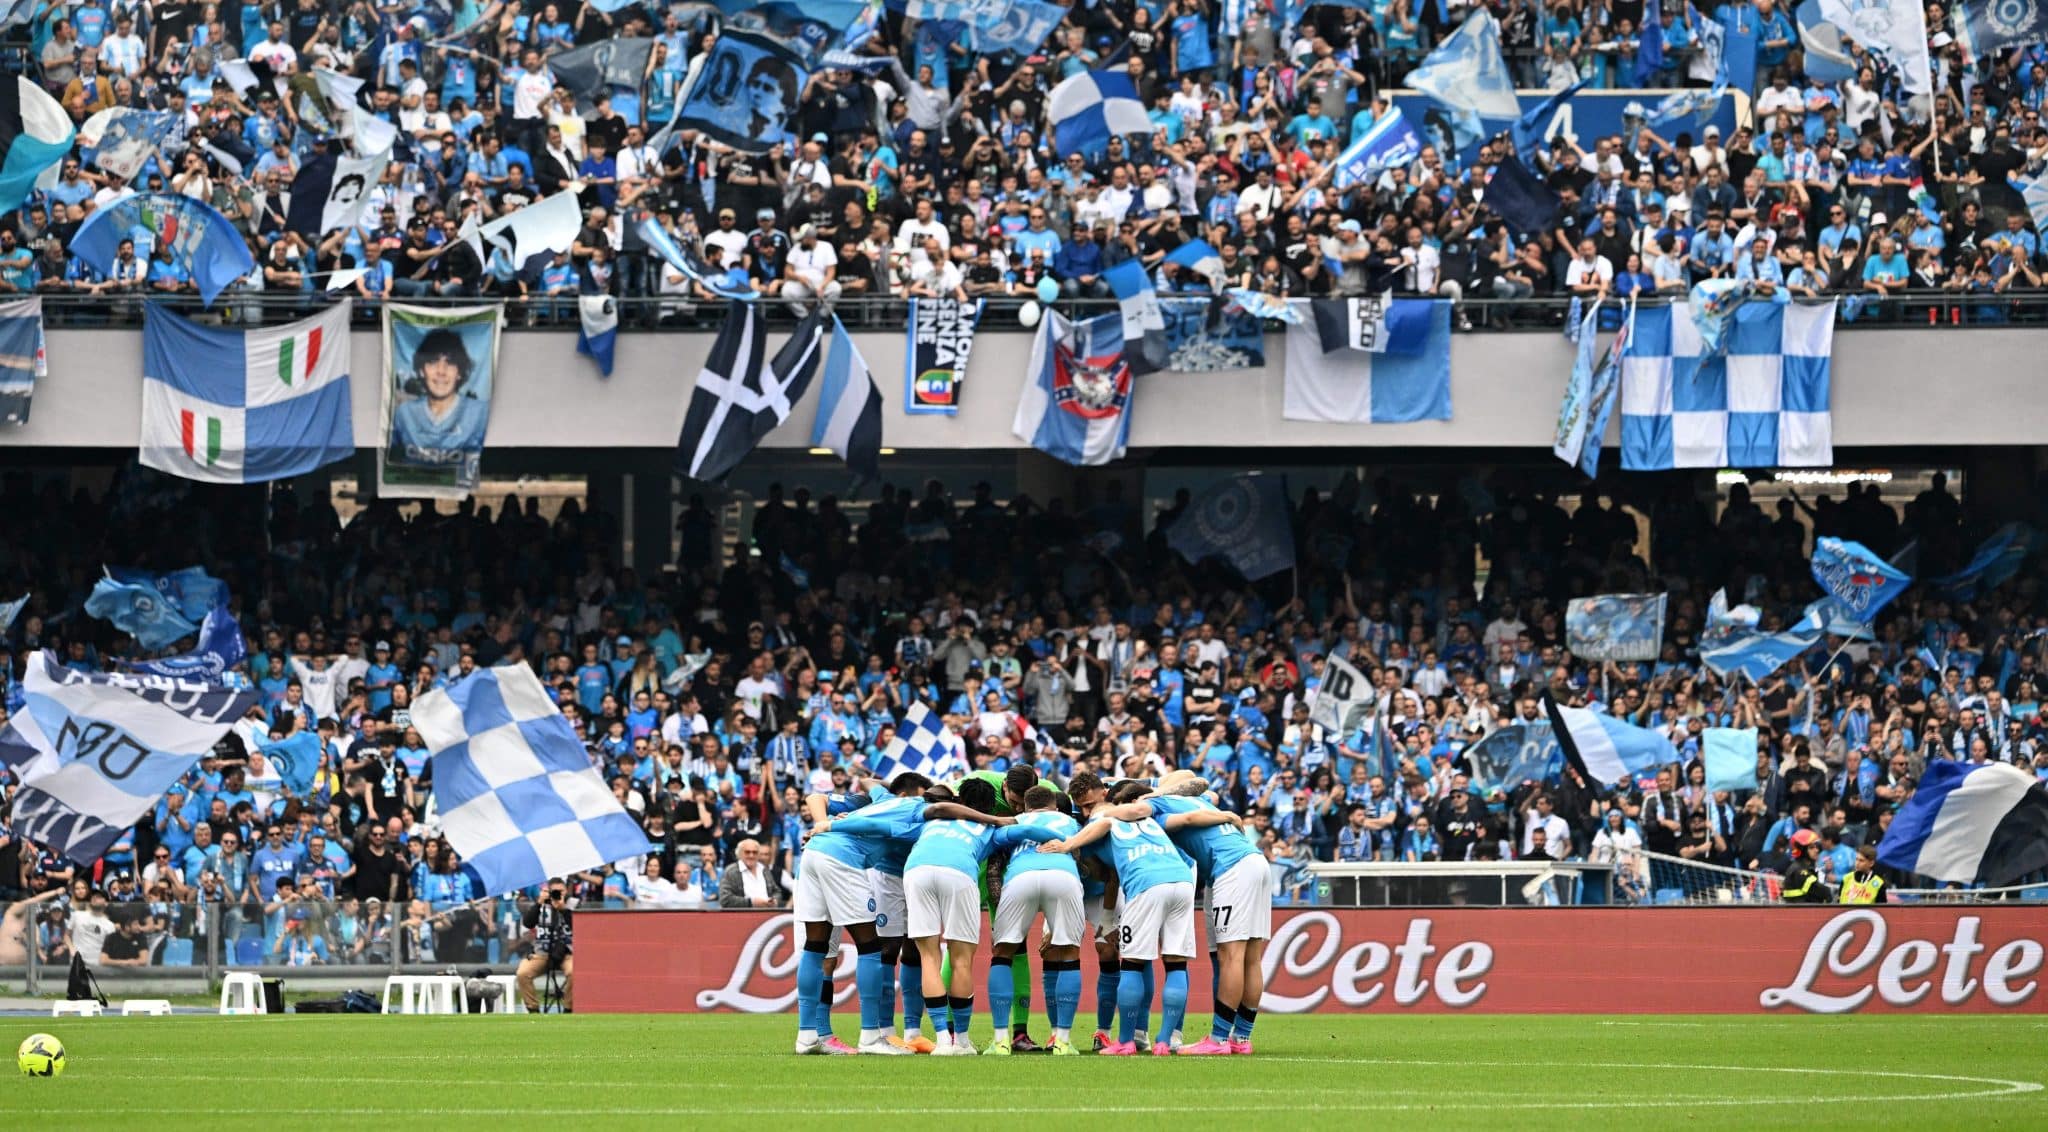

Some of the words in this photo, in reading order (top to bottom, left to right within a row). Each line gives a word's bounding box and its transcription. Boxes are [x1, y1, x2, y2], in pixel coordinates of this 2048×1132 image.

[918, 298, 938, 345] FINE
[935, 298, 958, 366] SENZA
[1323, 662, 1355, 701] 10
[1212, 905, 1233, 928] 77
[1259, 910, 1494, 1013] Lete
[1759, 909, 2044, 1013] Lete
